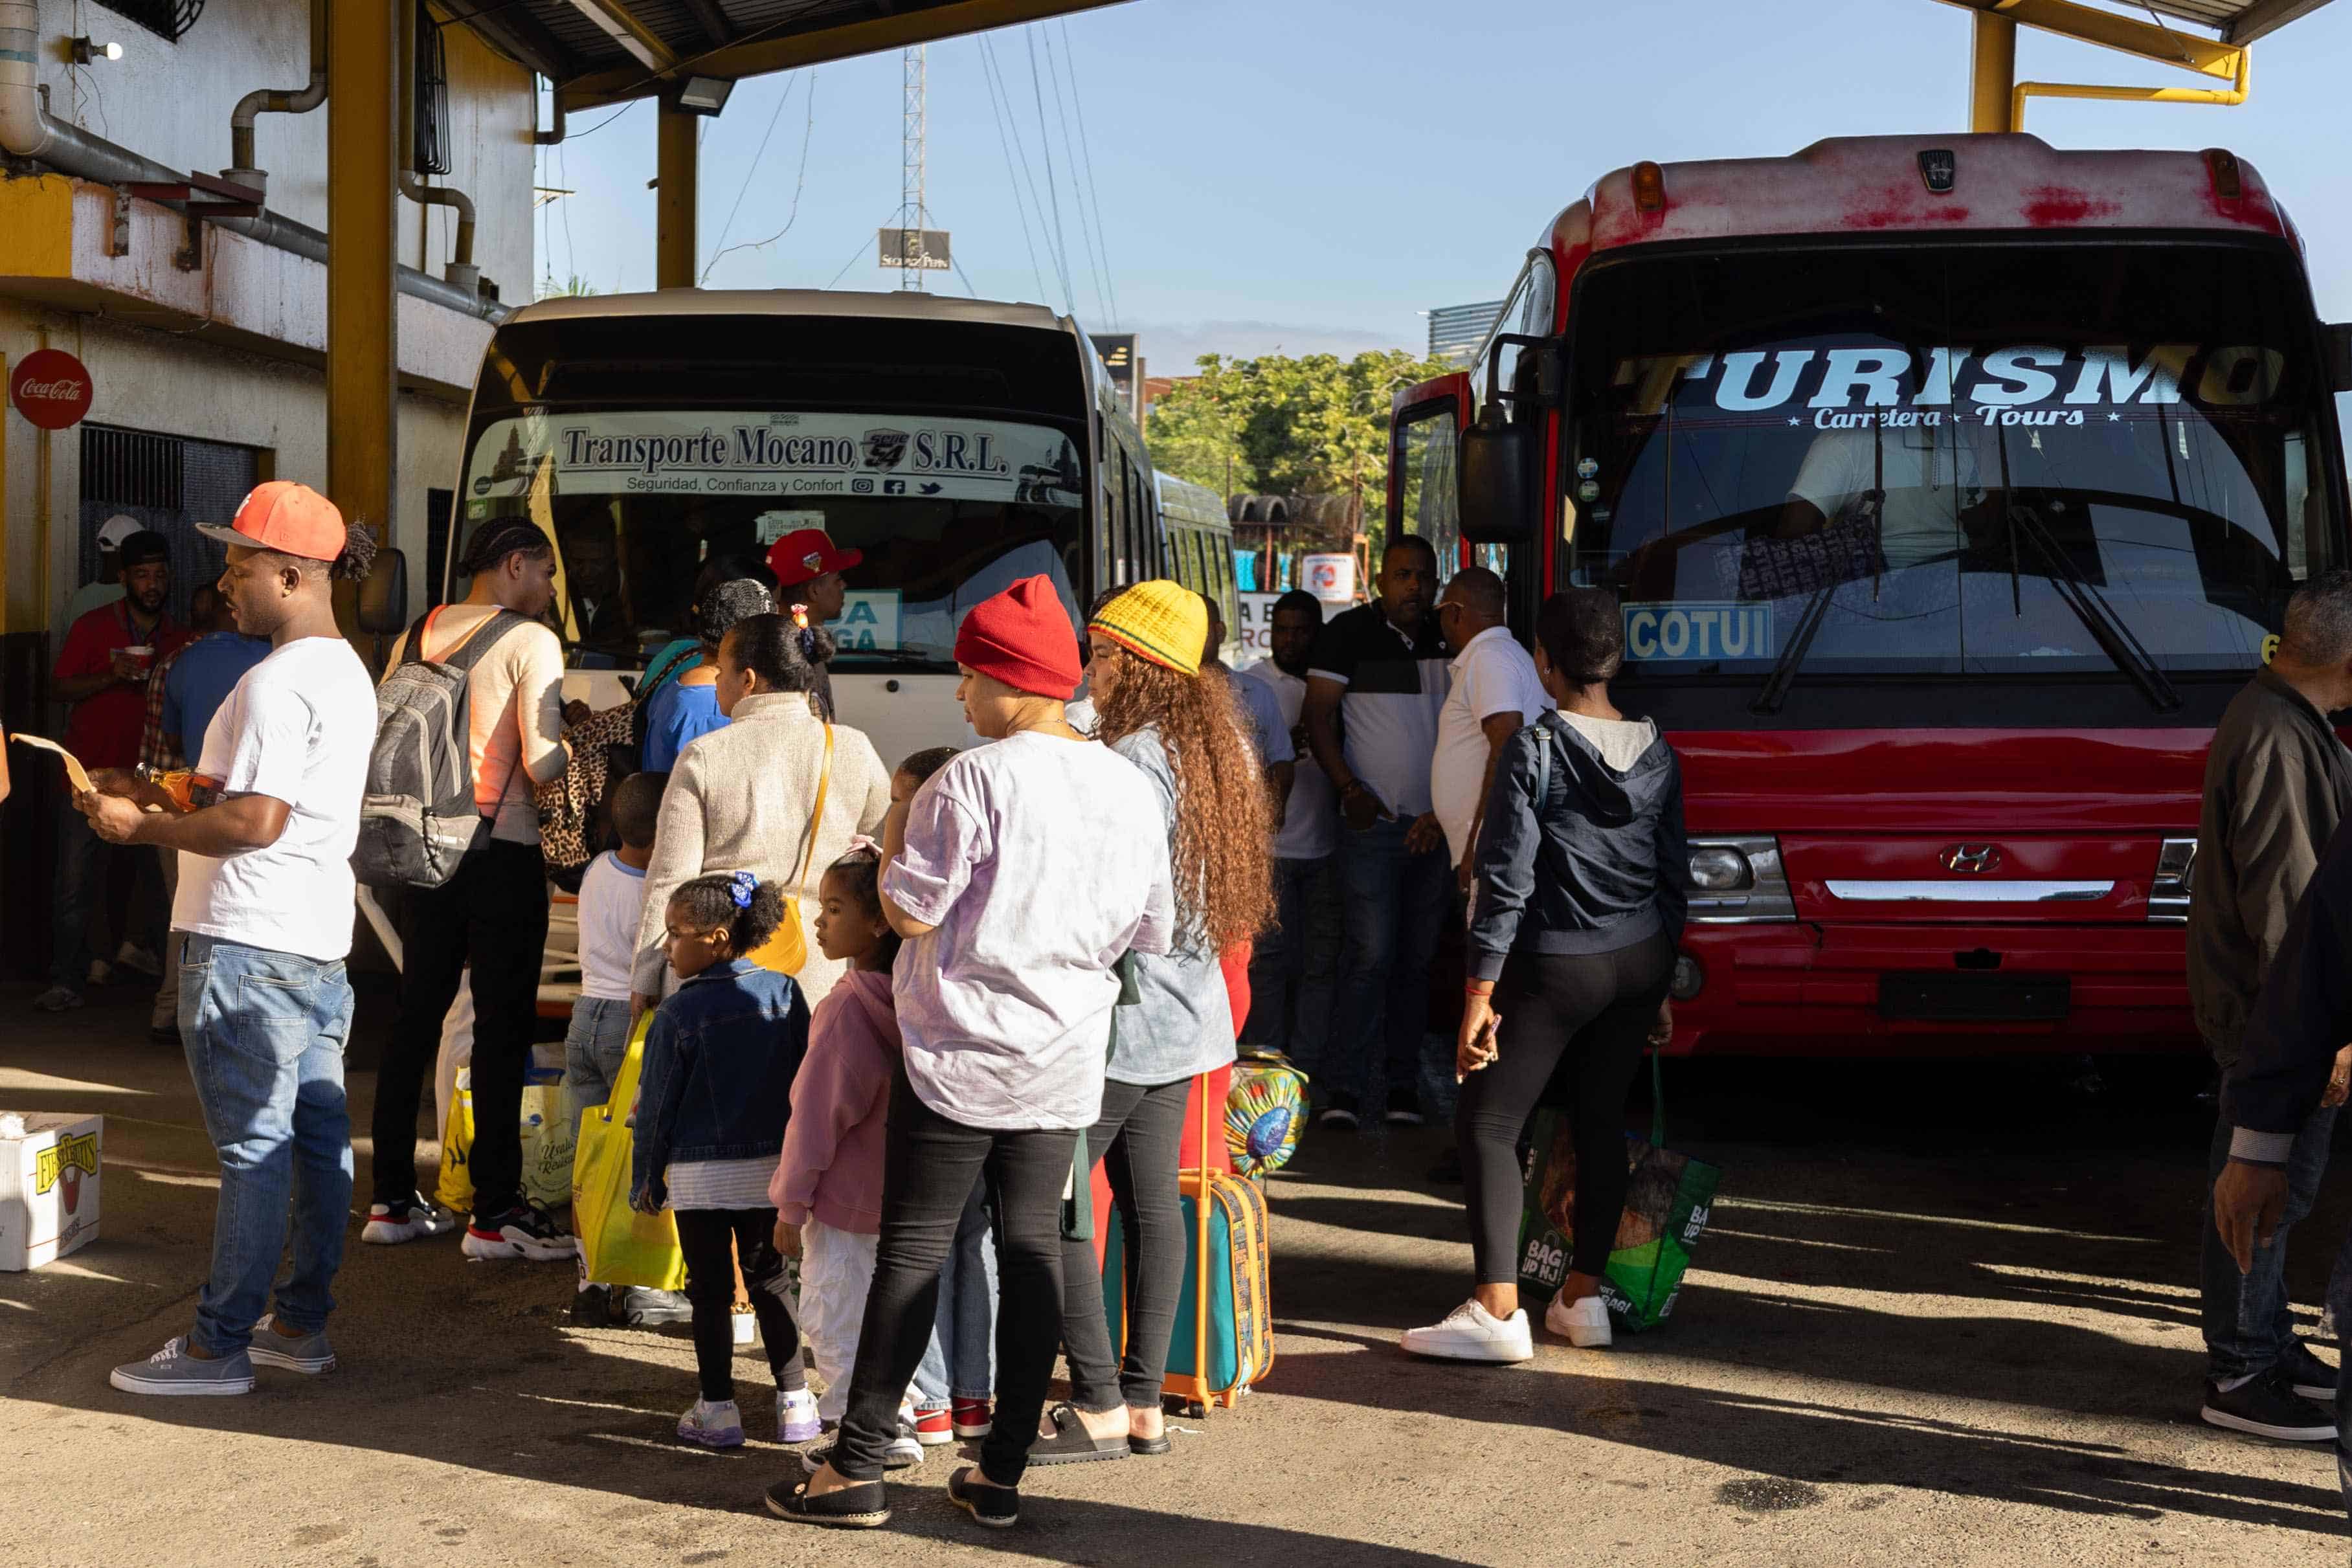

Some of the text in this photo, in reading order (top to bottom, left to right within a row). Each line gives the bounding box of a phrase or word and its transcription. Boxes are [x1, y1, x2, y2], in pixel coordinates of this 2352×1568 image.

[20, 378, 84, 401] Coca-Cola
[1615, 344, 2284, 412] TURISMO
[1814, 405, 2084, 429] Carretera Tours
[563, 426, 1009, 475] Transporte Mocano, S.R.L.
[627, 478, 844, 493] Seguridad, Confianza y Confort
[1629, 610, 1765, 658] COTUI
[1522, 1257, 1538, 1273] UP
[1527, 1239, 1562, 1266] BAG
